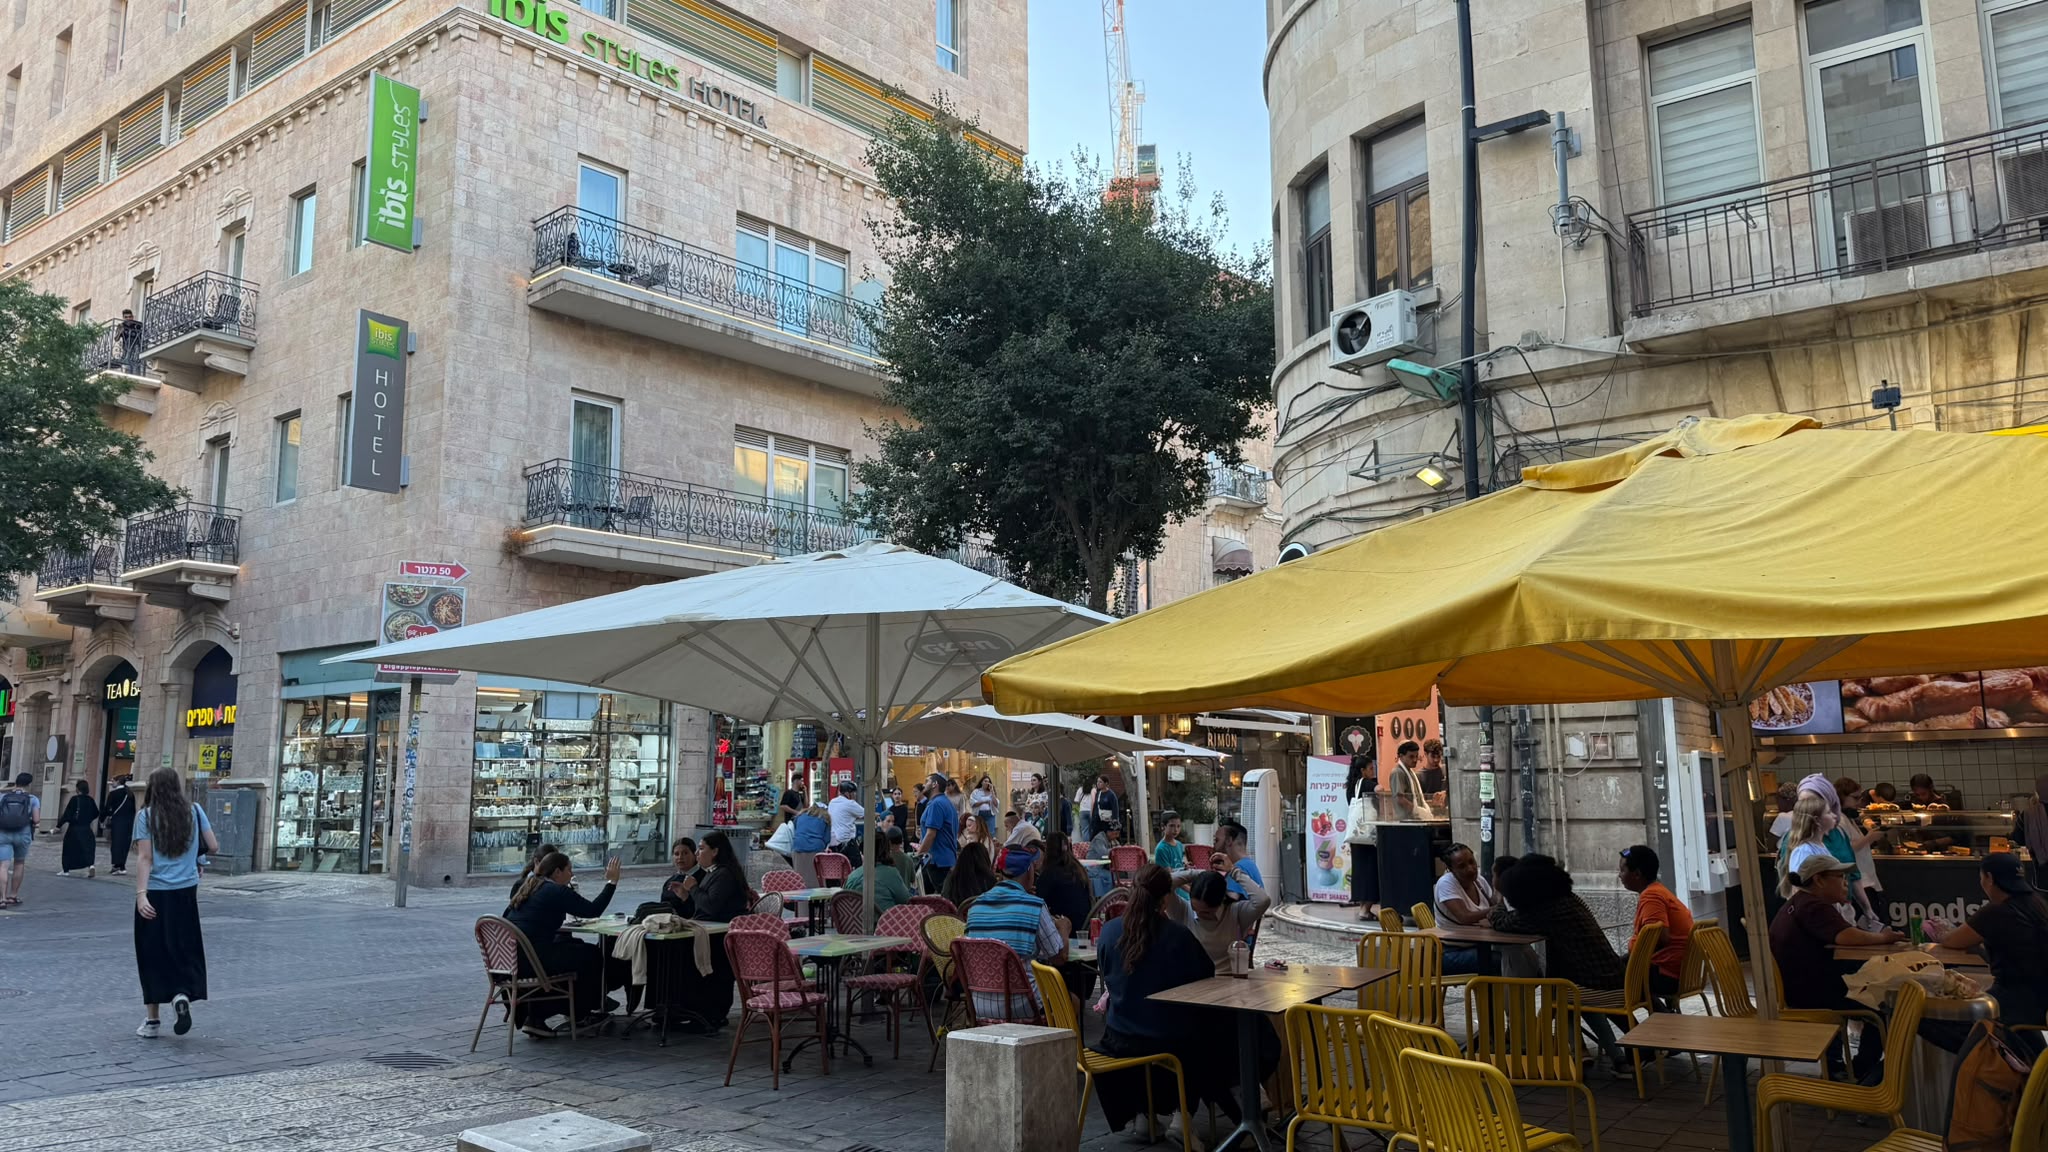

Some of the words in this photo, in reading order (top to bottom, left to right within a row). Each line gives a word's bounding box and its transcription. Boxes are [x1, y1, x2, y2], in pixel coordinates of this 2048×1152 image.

[689, 76, 764, 128] HOTEL
[379, 177, 406, 229] ibis
[375, 327, 393, 341] ibis
[371, 368, 388, 476] HOTEL
[415, 565, 437, 575] מטר
[439, 567, 451, 575] 50
[106, 683, 122, 700] TEA
[186, 707, 214, 727] ספרים
[894, 744, 920, 755] SALE
[1310, 782, 1330, 790] פירות
[1320, 794, 1338, 802] שלנו
[1329, 893, 1350, 901] SHAKES
[1888, 897, 1990, 928] goods
